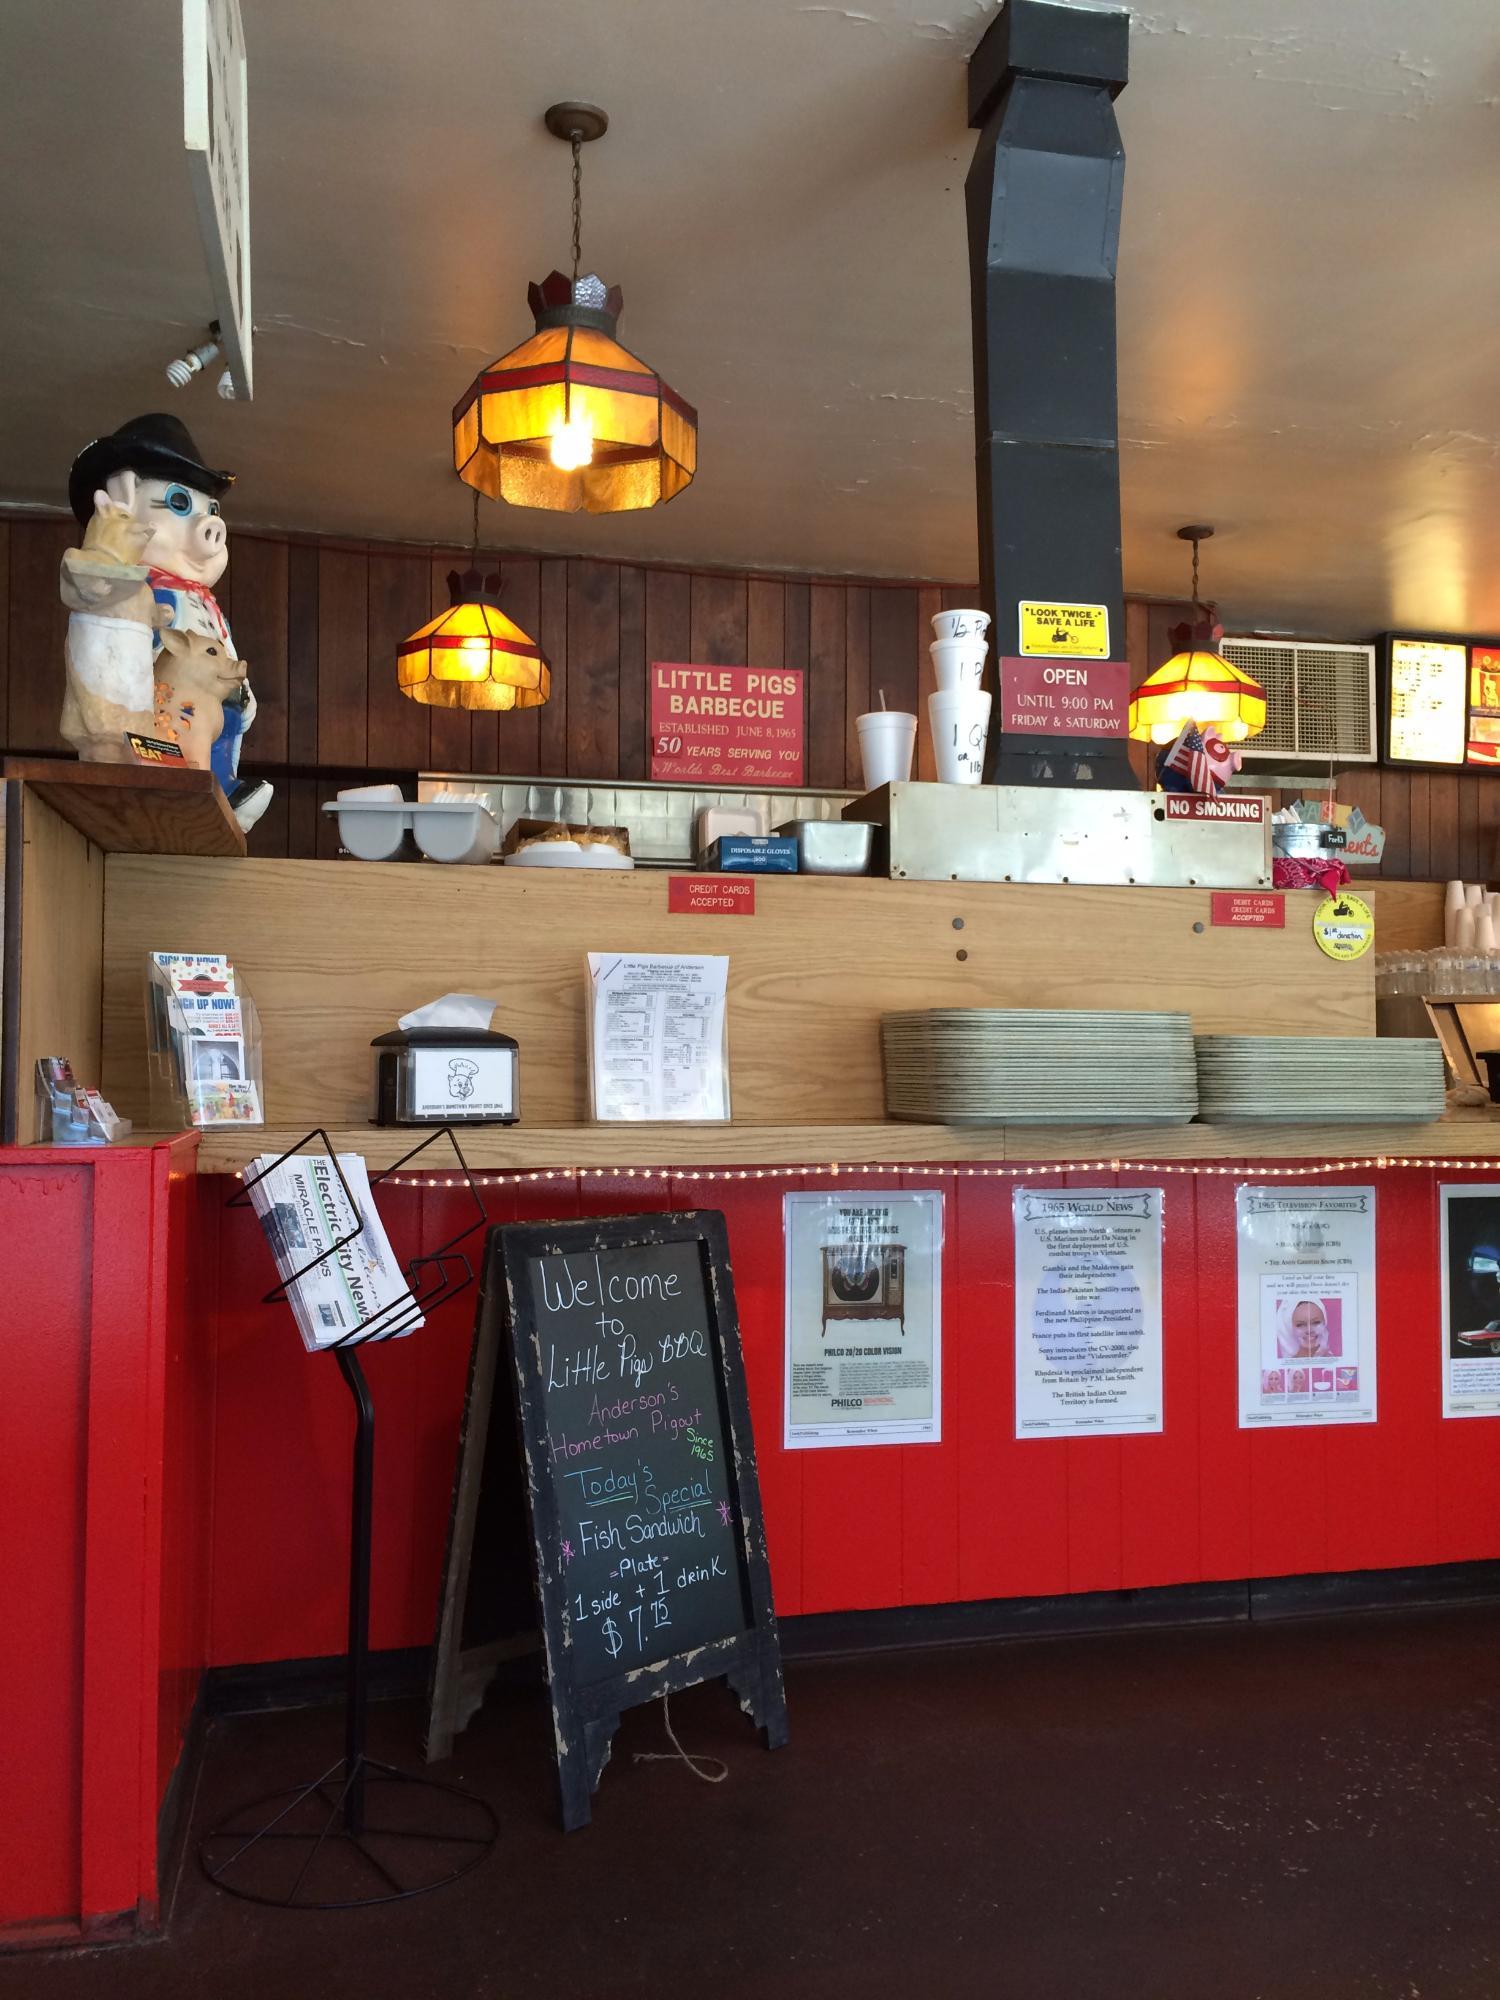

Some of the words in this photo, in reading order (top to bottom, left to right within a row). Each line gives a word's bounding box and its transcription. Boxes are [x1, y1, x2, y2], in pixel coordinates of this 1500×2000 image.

[1031, 608, 1058, 617] LOOK
[1061, 609, 1092, 619] TWICE
[1036, 617, 1062, 626] SAVE
[1065, 618, 1072, 626] A
[1075, 619, 1095, 628] LIFE
[657, 669, 732, 692] LITTLE
[747, 674, 797, 696] PIGS
[1043, 668, 1088, 686] OPEN
[670, 695, 785, 719] BARBECUE
[1017, 693, 1056, 709] UNTIL
[1061, 696, 1088, 710] 9:00
[1094, 698, 1114, 711] PM
[659, 722, 729, 736] ESTABLISHED
[736, 726, 763, 738] JUNE
[1011, 714, 1048, 727] FRIDAY
[1053, 716, 1061, 727] &
[1066, 717, 1121, 730] SATURDAY
[656, 736, 682, 754] 50
[686, 746, 721, 758] YEARS
[727, 747, 772, 760] SERVING
[778, 750, 800, 761] YOU
[709, 763, 738, 776] Best
[741, 764, 793, 778] Barbecue
[1169, 799, 1190, 815] NO
[1195, 801, 1260, 818] SMOKING
[689, 884, 718, 894] CREDIT
[722, 885, 750, 895] CARDS
[690, 897, 735, 907] ACCEPTED
[1233, 898, 1251, 906] DEBIT
[1231, 914, 1265, 922] ACCEPTED
[196, 999, 209, 1010] UP
[211, 999, 235, 1010] NOW!
[293, 1174, 319, 1235] MIRACLE
[1106, 1202, 1133, 1212] NEWS
[314, 1166, 342, 1232] Electric
[347, 1276, 371, 1324] News
[540, 1254, 682, 1312] Welcome
[595, 1311, 625, 1338] to
[824, 1348, 844, 1357] PHILCO
[845, 1346, 862, 1358] 20/20
[863, 1347, 881, 1356] COLOR
[882, 1346, 902, 1355] VISION
[548, 1344, 611, 1393] Little
[618, 1333, 654, 1389] Pigs
[658, 1330, 707, 1363] BBQ
[587, 1381, 679, 1427] Anderson's
[831, 1398, 863, 1407] PHILCO
[550, 1426, 639, 1464] Hometown
[651, 1408, 702, 1441] Pigout
[686, 1427, 714, 1448] Since
[690, 1445, 714, 1462] 1965
[563, 1458, 653, 1505] Today's
[645, 1468, 713, 1515] Special
[579, 1520, 627, 1556] Fish
[626, 1510, 706, 1544] Sandwich
[575, 1594, 589, 1621] 1
[591, 1590, 622, 1616] side
[636, 1584, 646, 1598] +
[653, 1571, 670, 1595] 1
